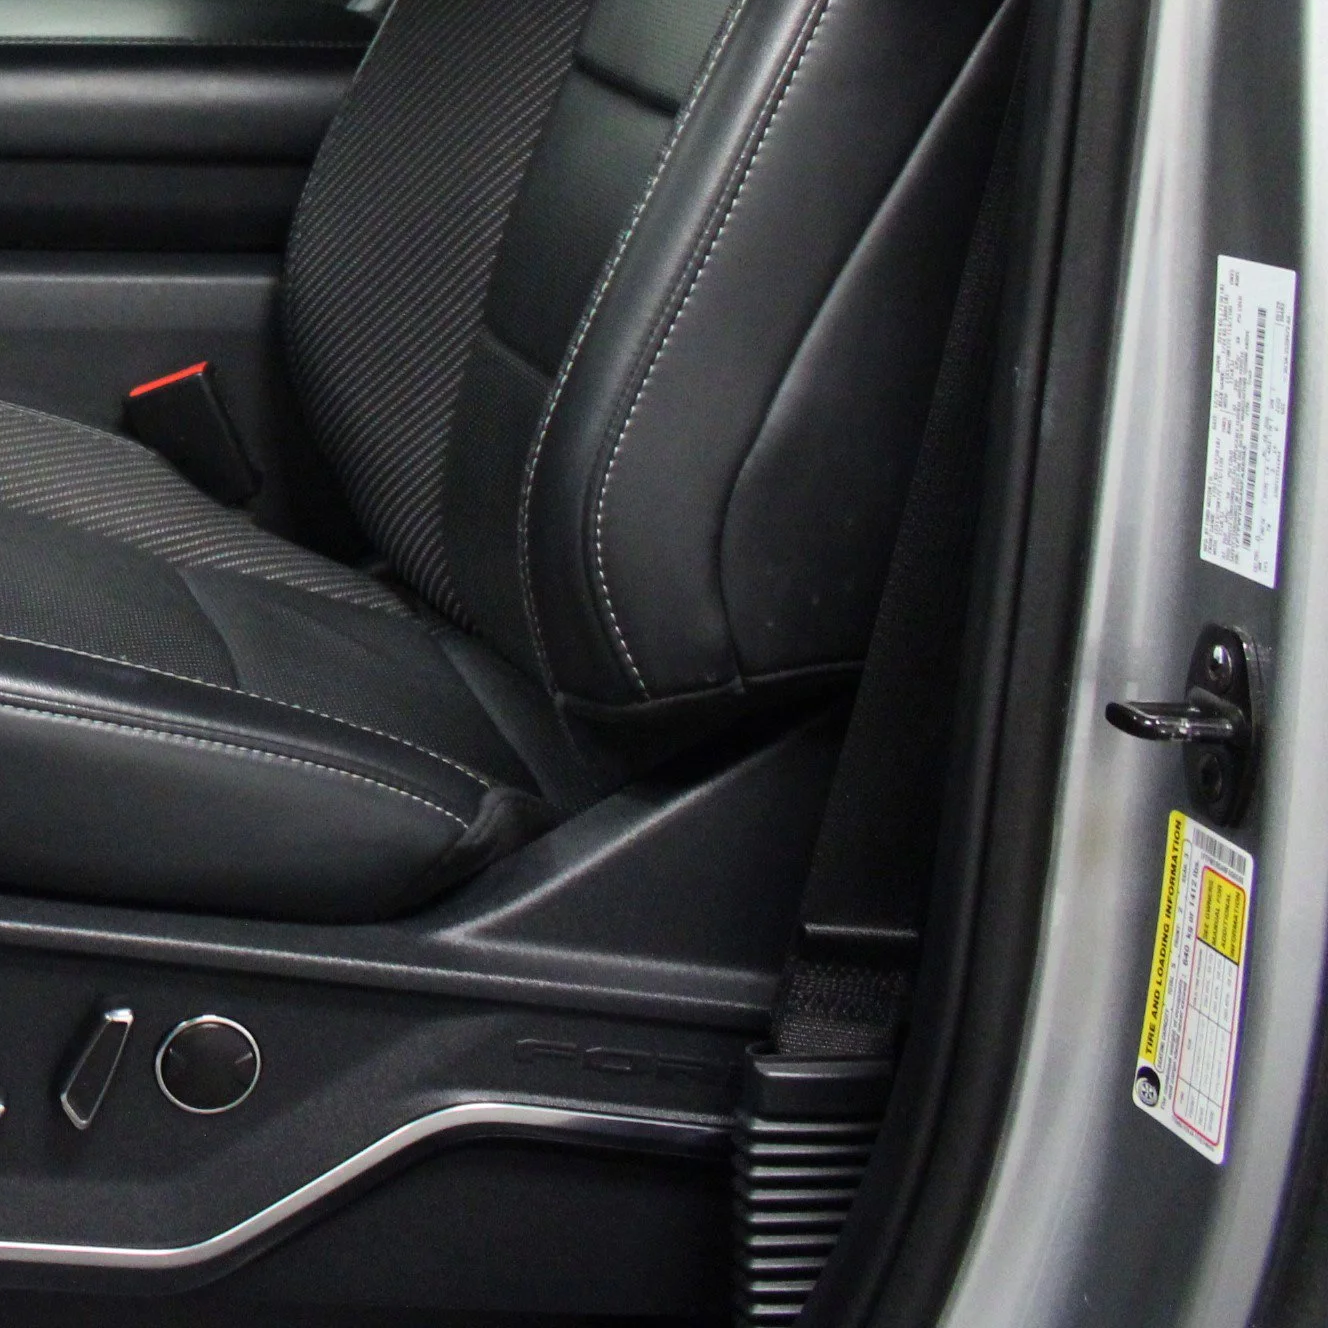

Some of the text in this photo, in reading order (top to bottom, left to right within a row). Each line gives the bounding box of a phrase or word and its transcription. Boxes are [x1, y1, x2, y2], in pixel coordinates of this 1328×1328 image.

[1188, 878, 1198, 907] 1412
[1187, 910, 1194, 924] or
[1146, 819, 1182, 1055] TIRE AND LOADING INFORMATION
[1185, 924, 1193, 940] kg
[1182, 942, 1190, 967] 640
